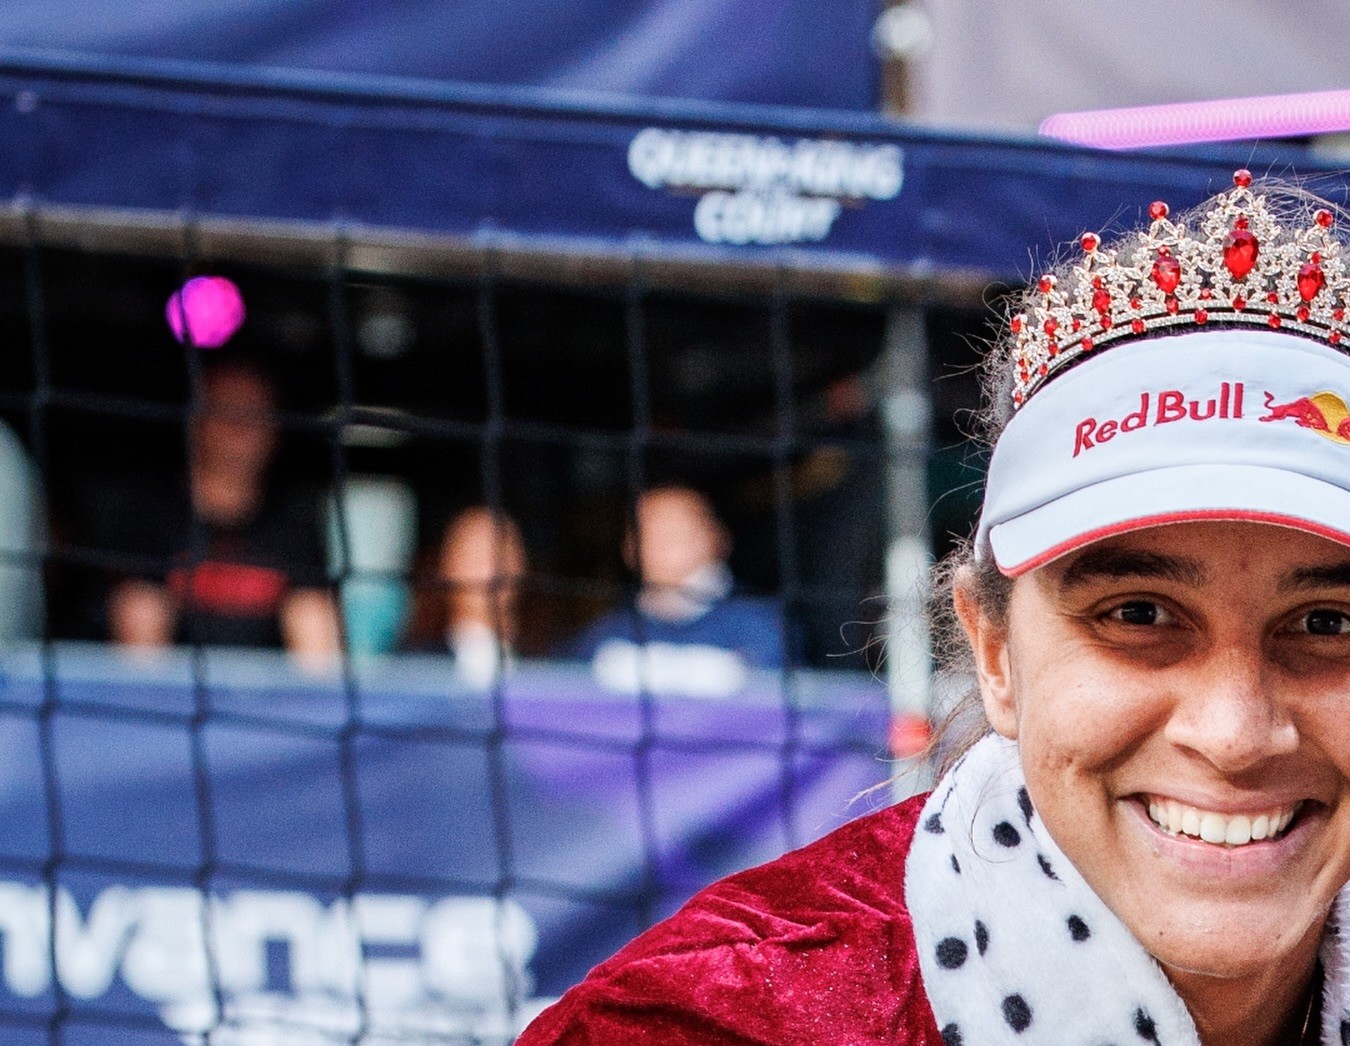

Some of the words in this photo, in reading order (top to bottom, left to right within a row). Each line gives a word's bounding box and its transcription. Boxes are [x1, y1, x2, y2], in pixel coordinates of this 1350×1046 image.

[694, 190, 840, 245] COURT
[1072, 391, 1150, 458] Red
[1153, 381, 1244, 427] Bull
